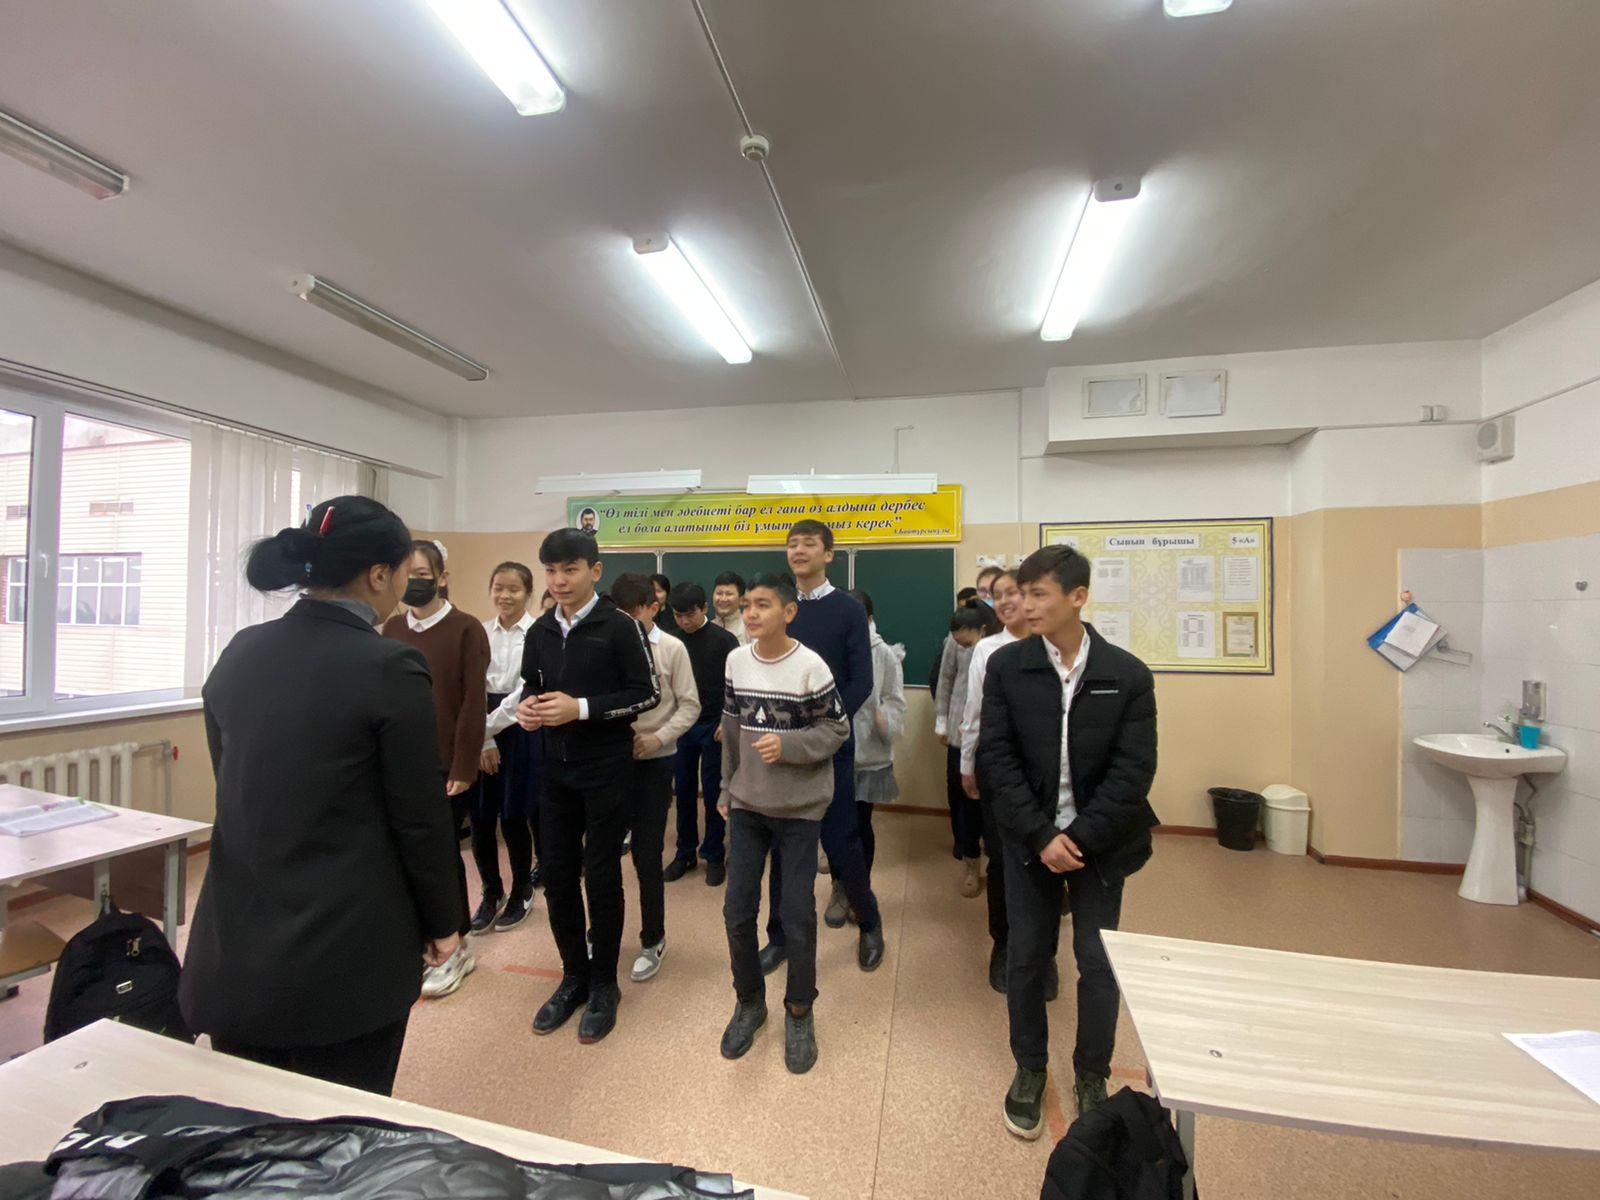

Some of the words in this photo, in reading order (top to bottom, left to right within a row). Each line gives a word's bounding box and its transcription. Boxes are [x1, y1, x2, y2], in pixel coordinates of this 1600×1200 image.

[623, 507, 648, 518] тілі
[652, 508, 675, 518] мен
[734, 504, 757, 518] бар
[826, 500, 877, 513] алдына
[880, 498, 926, 514] дербес
[634, 522, 661, 534] бола
